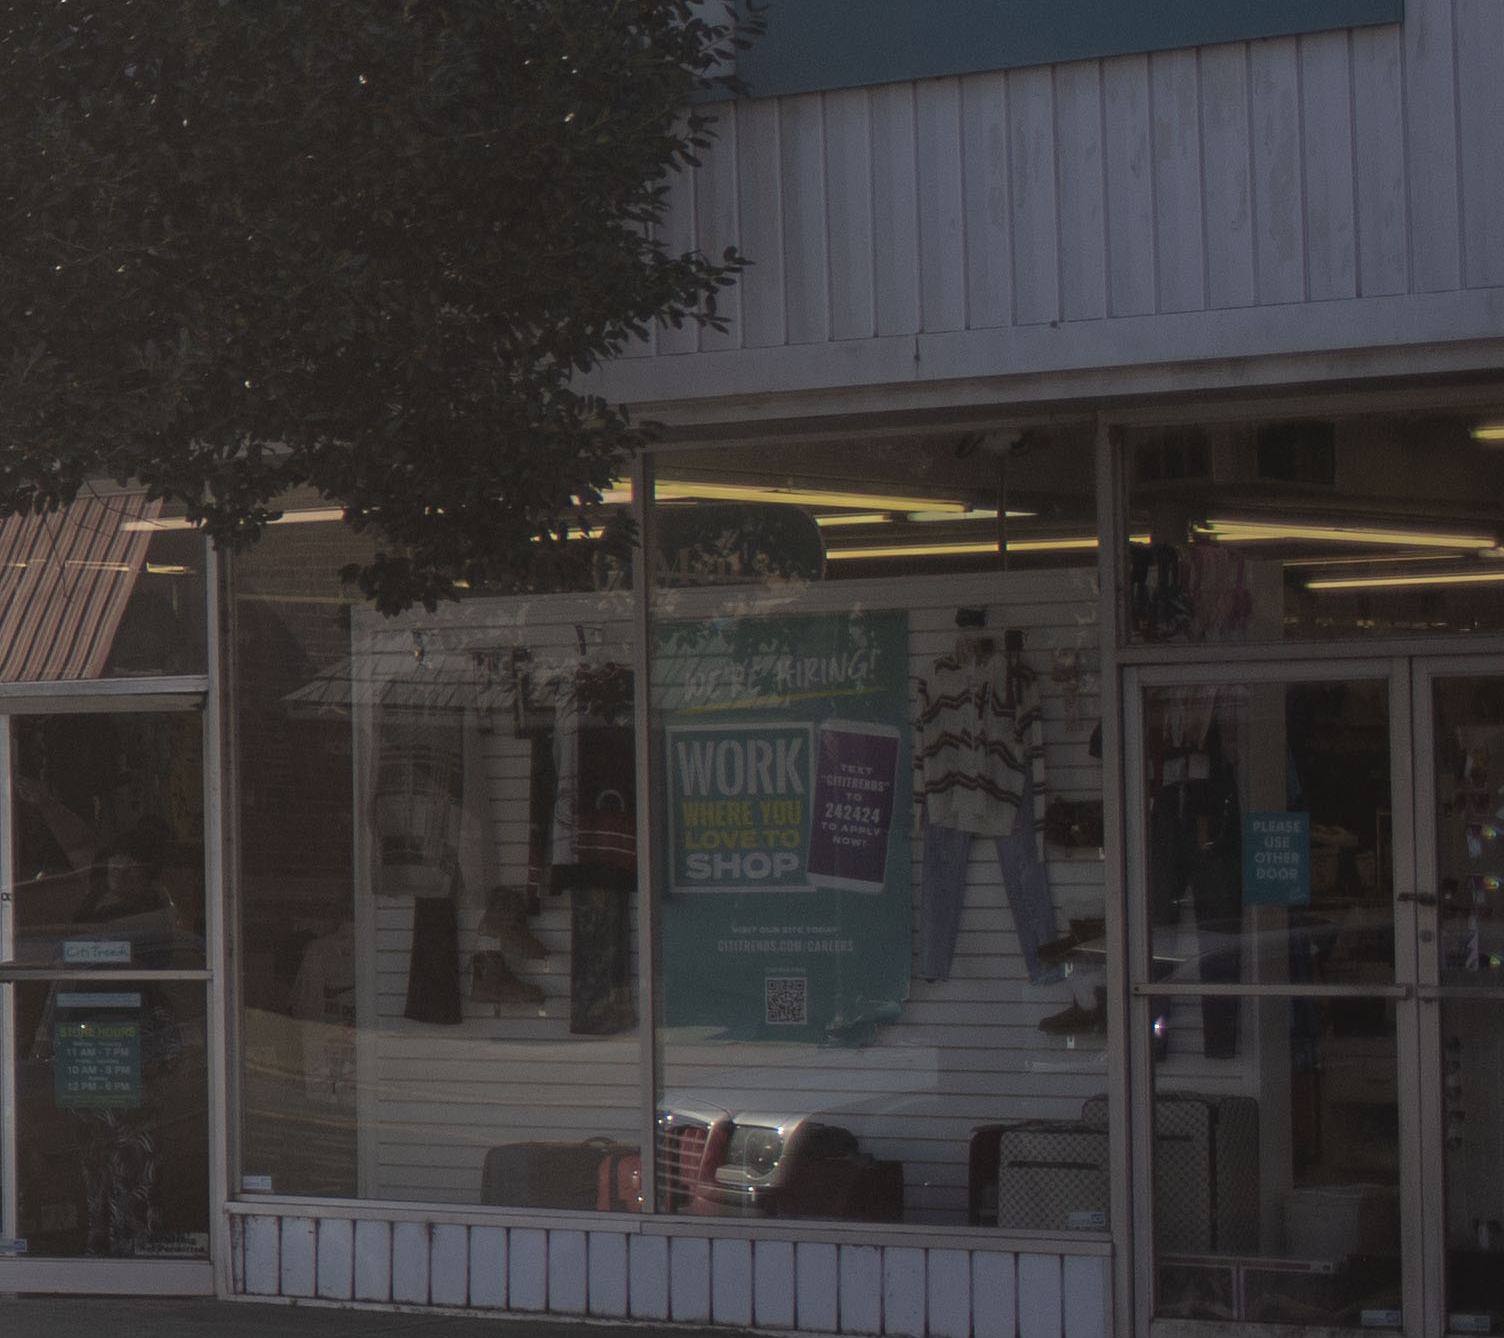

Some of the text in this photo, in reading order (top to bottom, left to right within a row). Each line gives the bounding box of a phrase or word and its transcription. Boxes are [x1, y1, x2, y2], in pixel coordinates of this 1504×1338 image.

[775, 649, 880, 692] HIRING!
[677, 738, 806, 796] WORK
[840, 764, 873, 774] TEXT
[846, 792, 862, 802] TO
[682, 799, 801, 827] WHERE YOU
[825, 803, 881, 823] 242424
[822, 822, 880, 837] TO APPLY
[1252, 820, 1302, 833] PLEASE
[685, 829, 800, 850] LOVE TO
[1264, 836, 1290, 848] USE
[1255, 852, 1300, 863] OTHER
[686, 852, 800, 879] SHOP
[1256, 868, 1299, 880] DOOR
[79, 1048, 96, 1056] AM
[113, 1048, 129, 1056] PM
[81, 1066, 97, 1074] AM
[114, 1066, 131, 1074] PM
[81, 1082, 96, 1091] PM
[114, 1082, 130, 1091] PM
